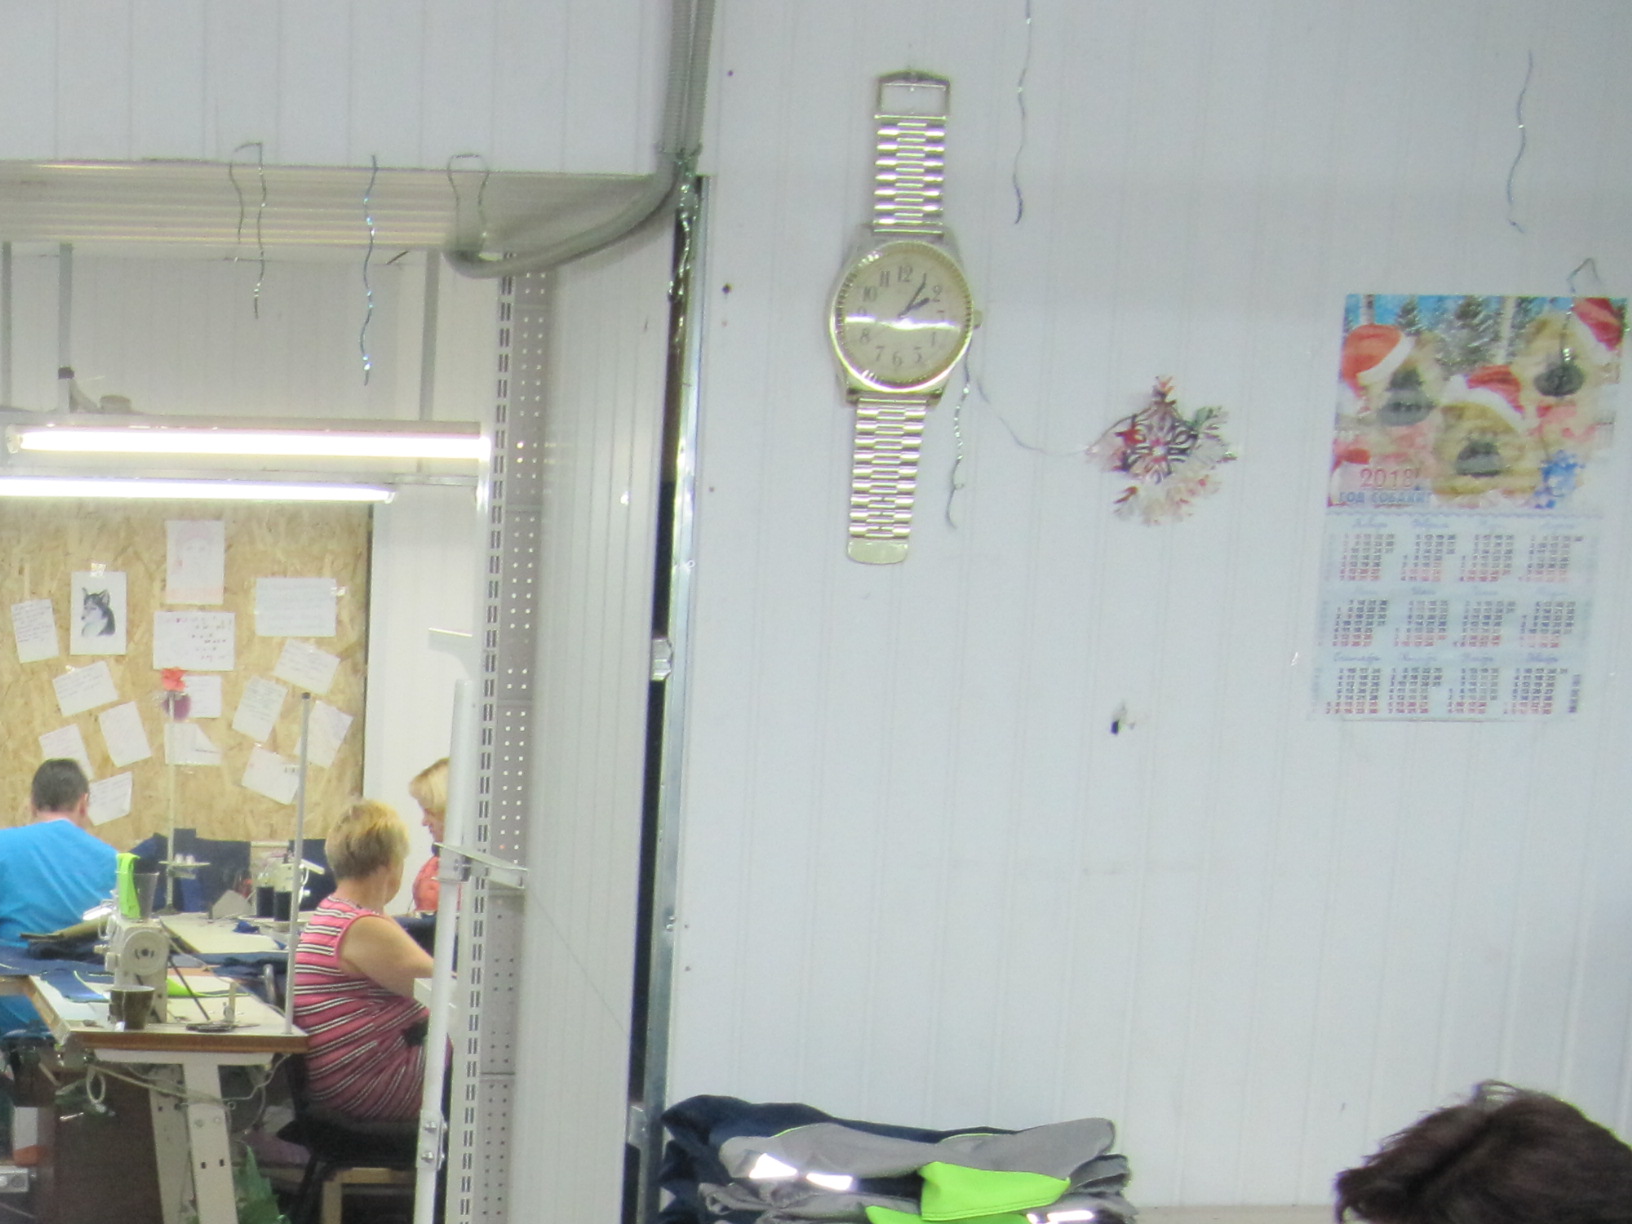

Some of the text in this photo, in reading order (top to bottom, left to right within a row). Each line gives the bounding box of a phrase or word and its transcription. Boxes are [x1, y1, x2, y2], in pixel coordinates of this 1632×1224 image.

[880, 271, 890, 287] 11
[897, 265, 913, 283] 12
[862, 286, 877, 303] 10
